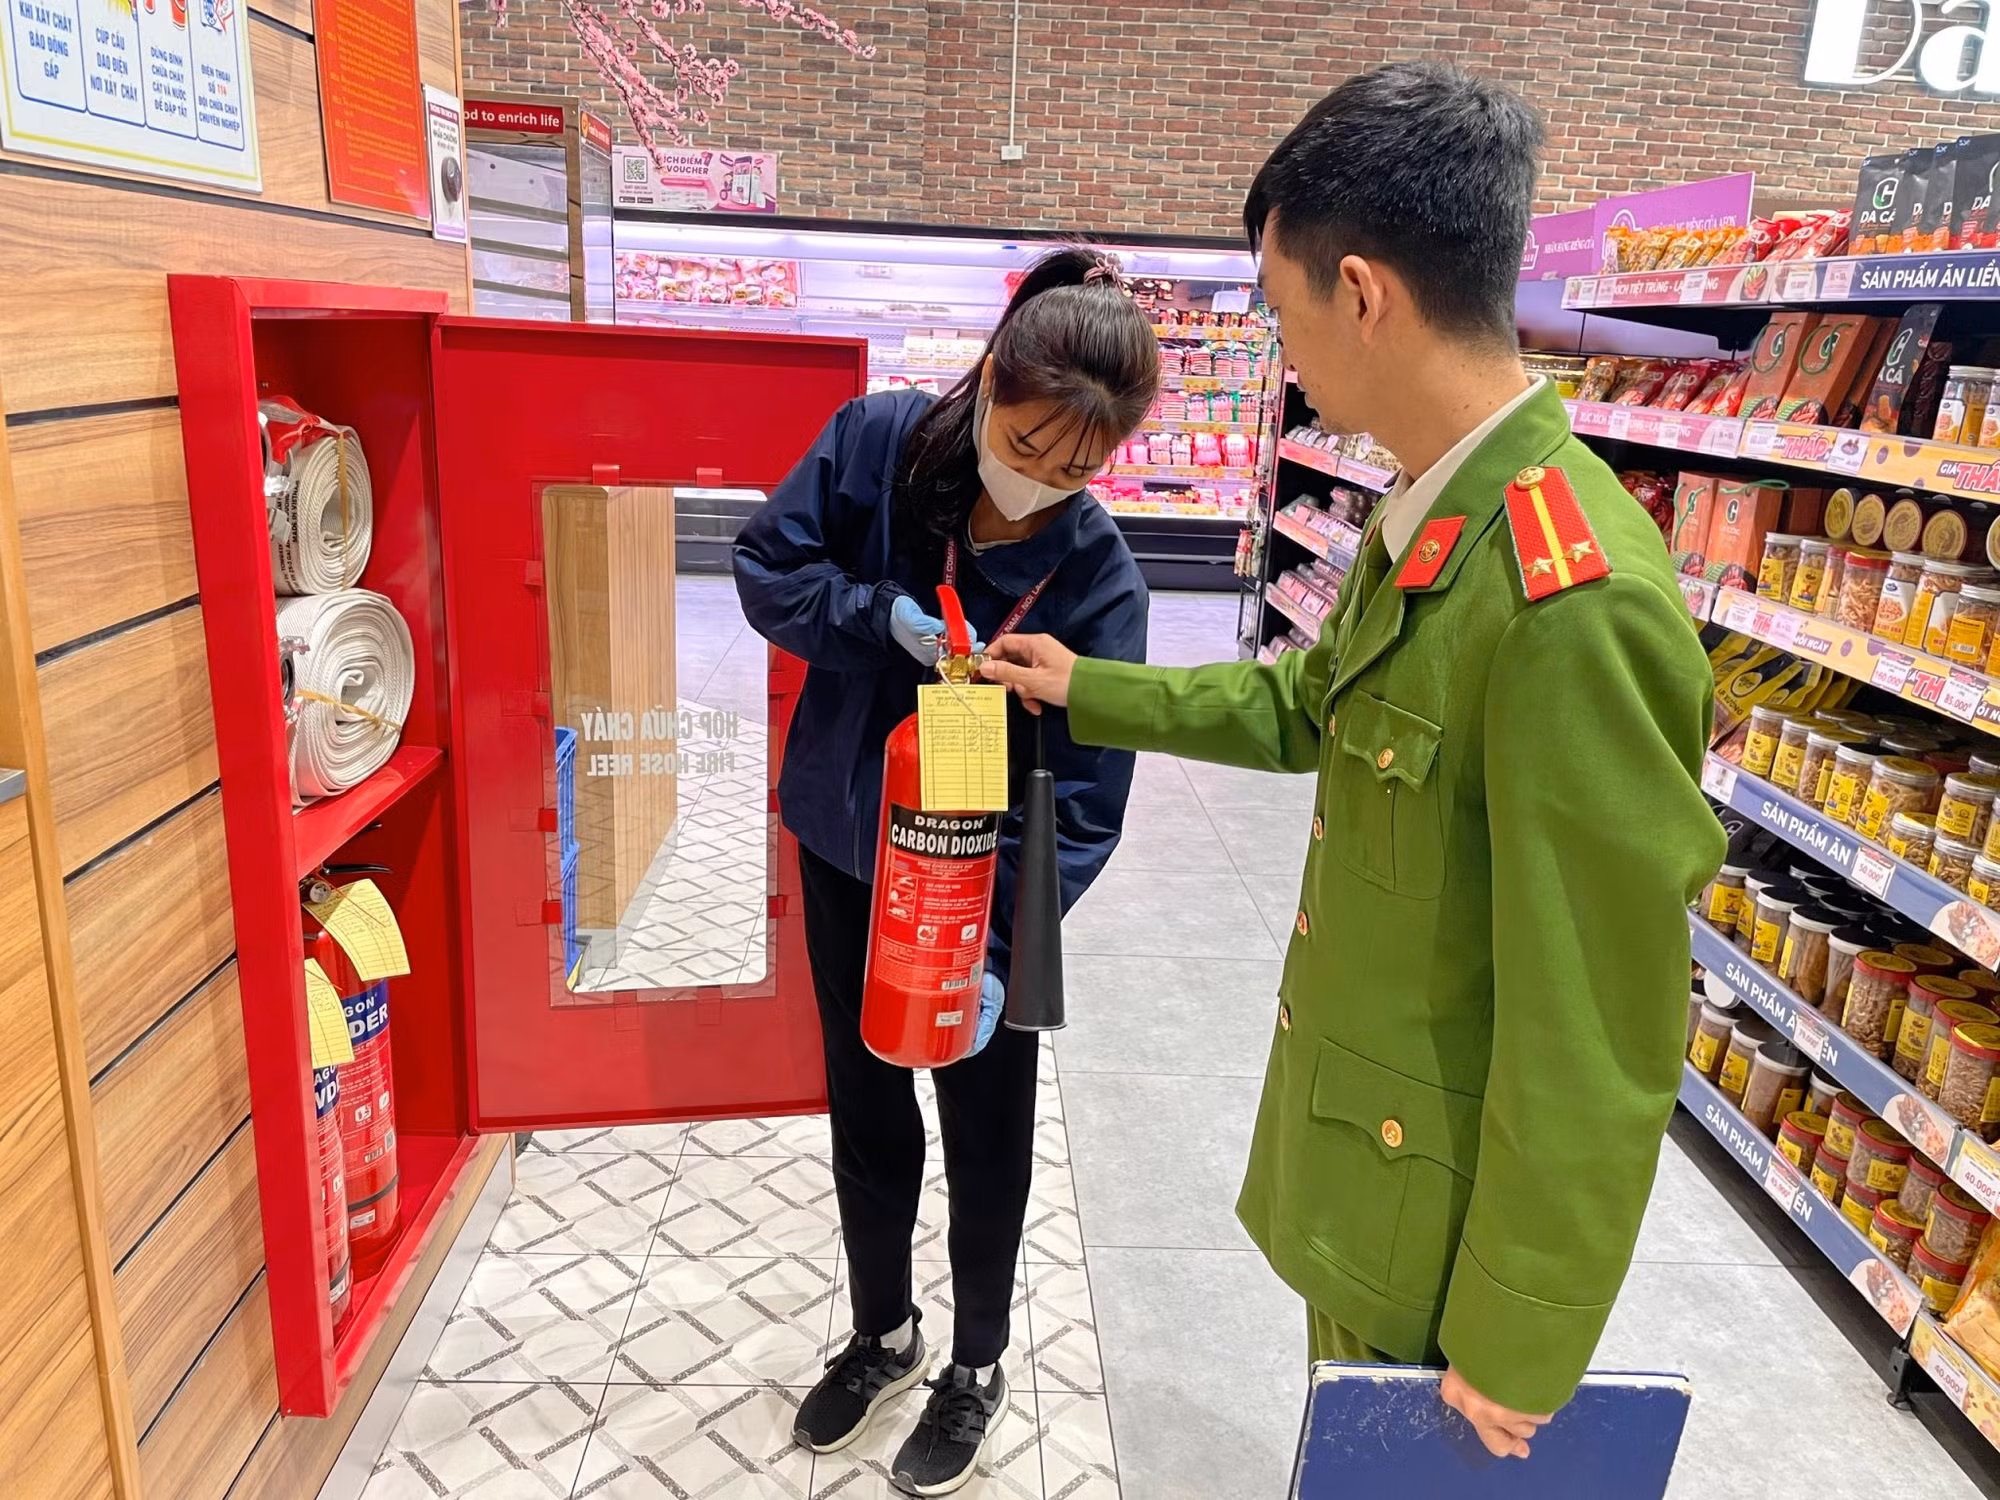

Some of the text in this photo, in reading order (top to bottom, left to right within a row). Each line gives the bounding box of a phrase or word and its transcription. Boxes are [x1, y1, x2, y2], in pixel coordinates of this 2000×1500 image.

[19, 1, 33, 19] KHI
[482, 111, 495, 121] to
[498, 113, 537, 125] enrich
[541, 115, 560, 127] life
[667, 166, 709, 175] VOUCHER
[1860, 211, 1876, 223] DA
[1860, 266, 1891, 289] SẢN
[1892, 262, 1939, 288] PHẨM
[1938, 263, 1966, 288] ĂN
[1782, 430, 1829, 461] THẤP
[1940, 462, 1957, 476] GIÁ
[291, 511, 298, 520] IN
[1004, 613, 1021, 633] NAM
[1911, 671, 1946, 702] TH
[914, 815, 984, 830] DRAGON
[891, 823, 998, 855] CARBON DIOXIDE
[1761, 801, 1851, 866] SẢN PHẨM ĂN
[1725, 962, 1798, 1032] SẢN PHẨM Ă
[1705, 1104, 1729, 1136] SẢN
[1729, 1128, 1763, 1172] PHẨM
